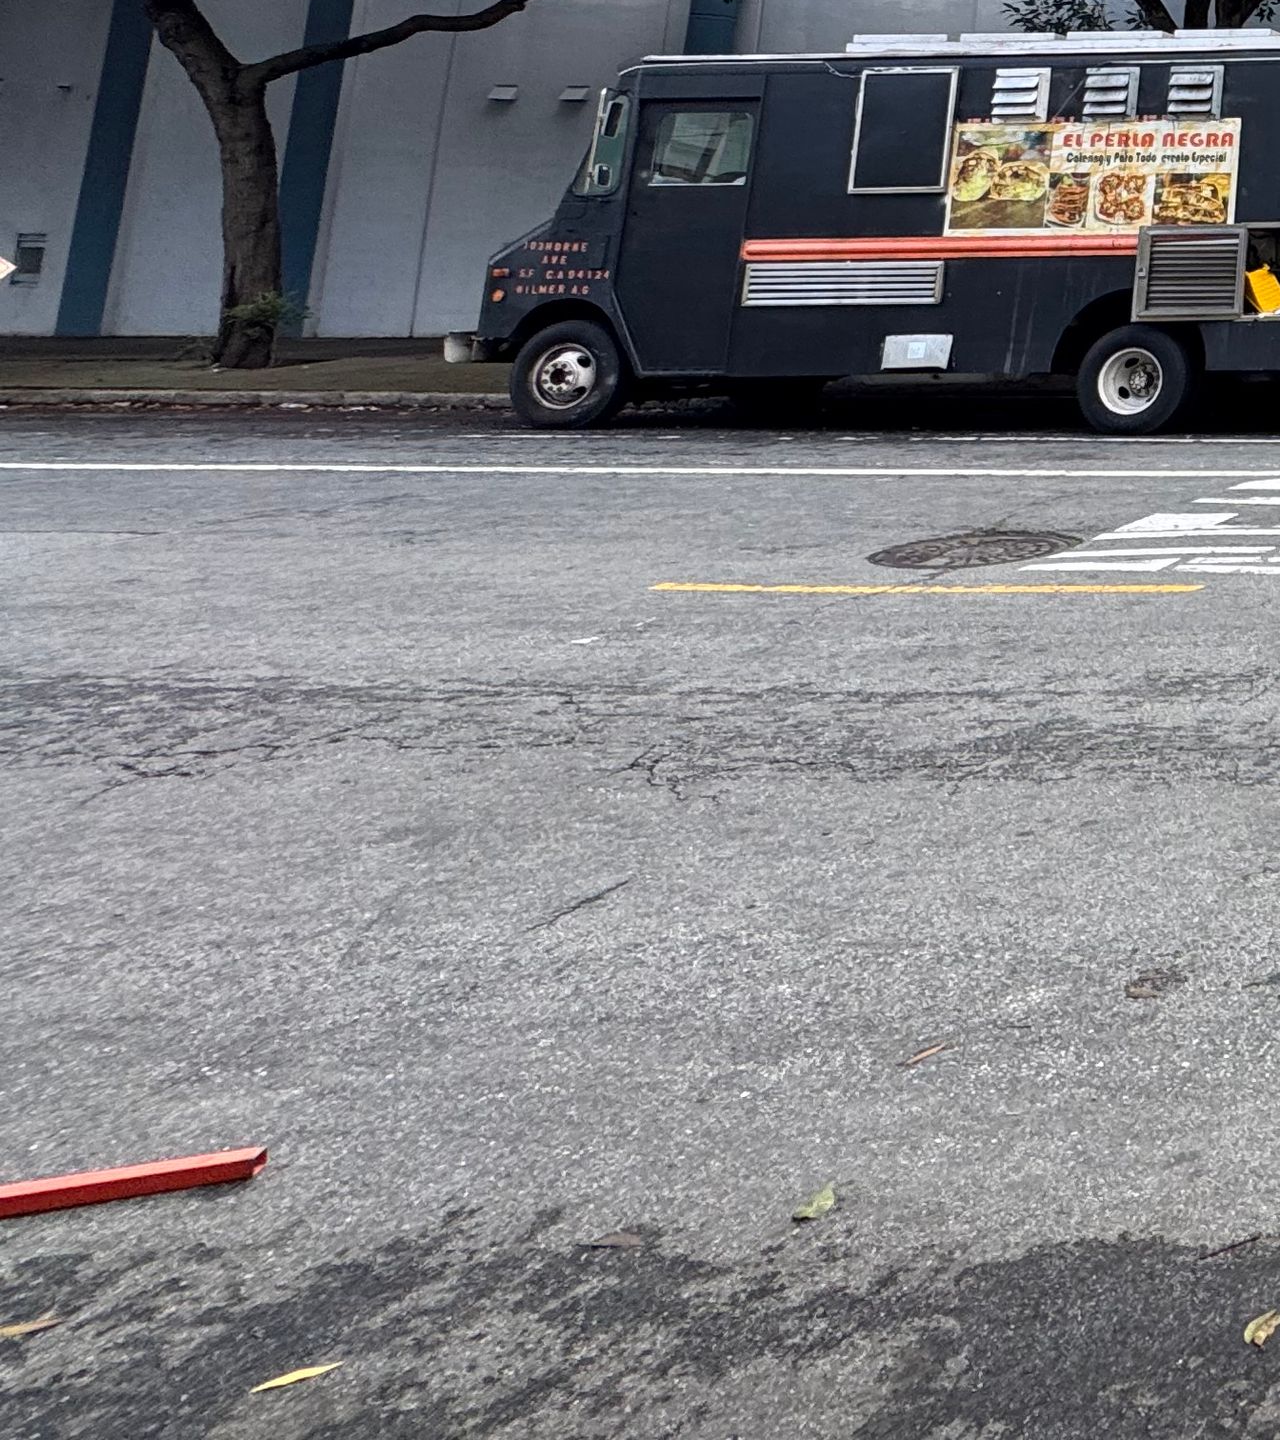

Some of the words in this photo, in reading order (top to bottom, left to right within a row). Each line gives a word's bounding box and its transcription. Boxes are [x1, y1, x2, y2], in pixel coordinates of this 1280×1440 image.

[1063, 133, 1083, 148] EL
[1089, 132, 1155, 148] PERLA
[1161, 132, 1234, 148] NEGRA
